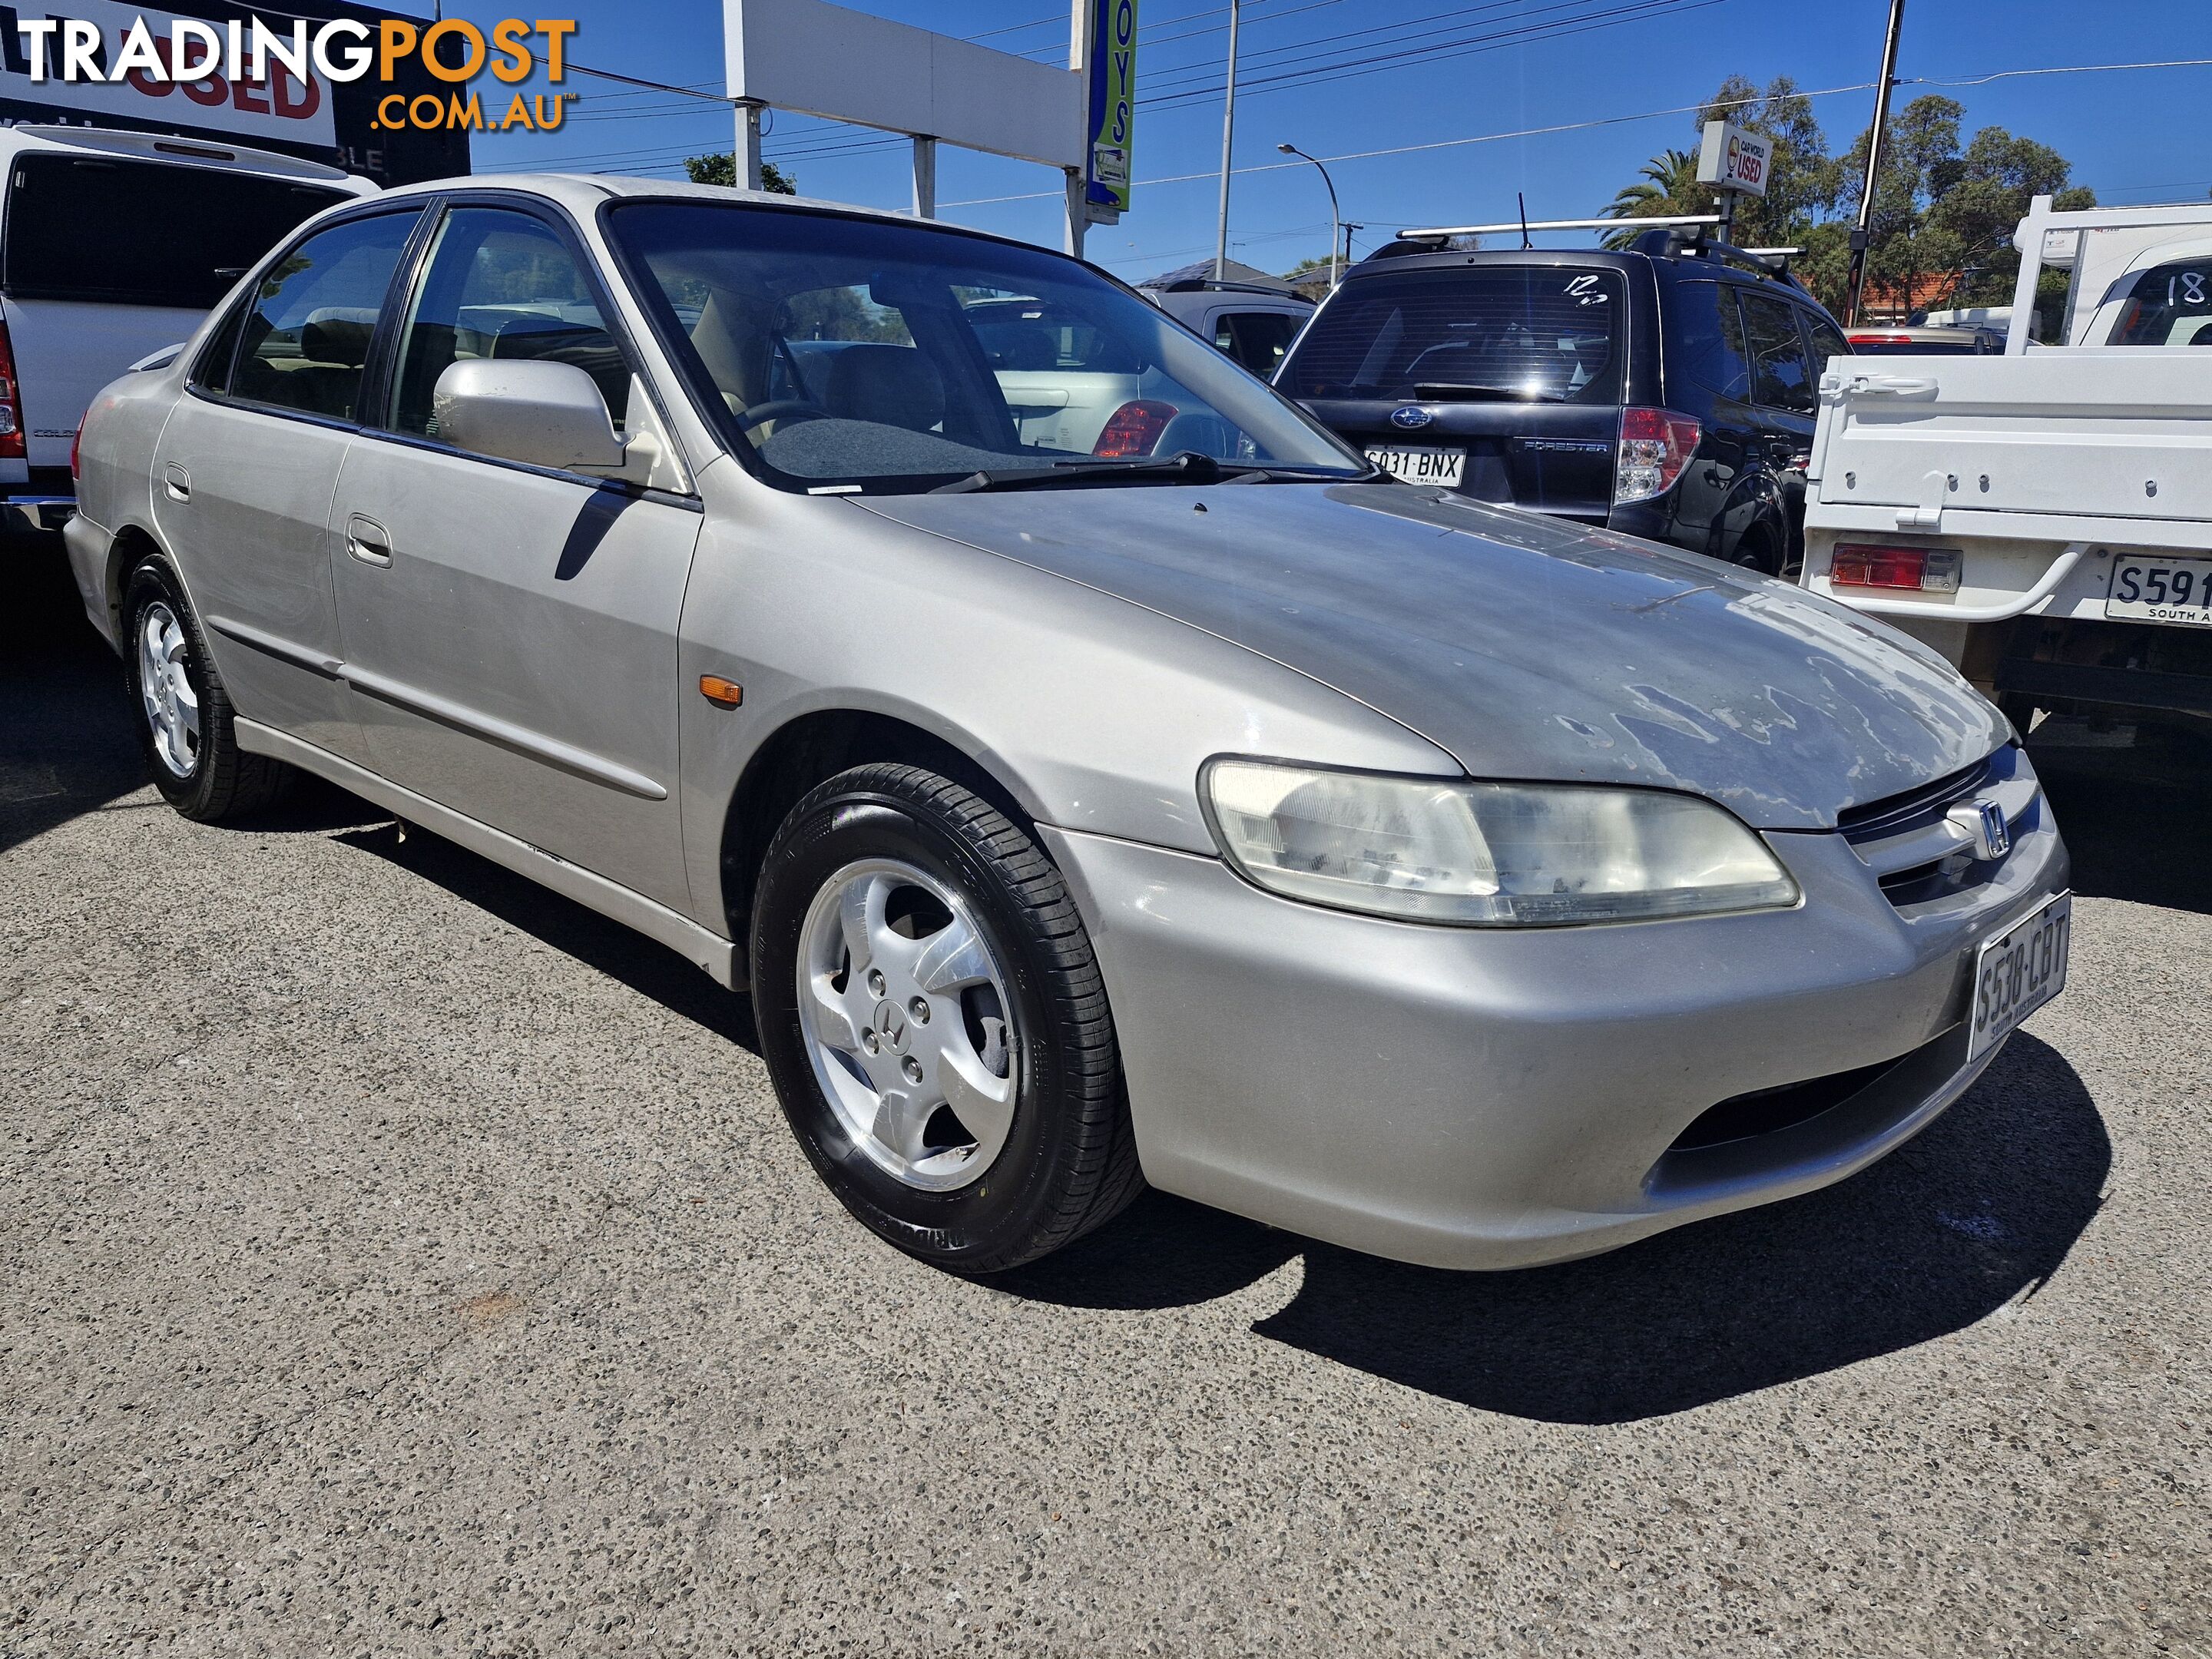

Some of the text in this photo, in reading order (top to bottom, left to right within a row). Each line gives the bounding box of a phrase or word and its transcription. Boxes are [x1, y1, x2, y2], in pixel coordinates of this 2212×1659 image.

[121, 29, 320, 120] USED
[1740, 141, 1750, 154] CAR
[1738, 154, 1761, 184] USED
[2168, 272, 2206, 306] 18
[1525, 441, 1608, 452] FORESTER
[2148, 608, 2196, 621] SOUTH
[1992, 985, 2048, 1039] SOUTH AUSTRALIA
